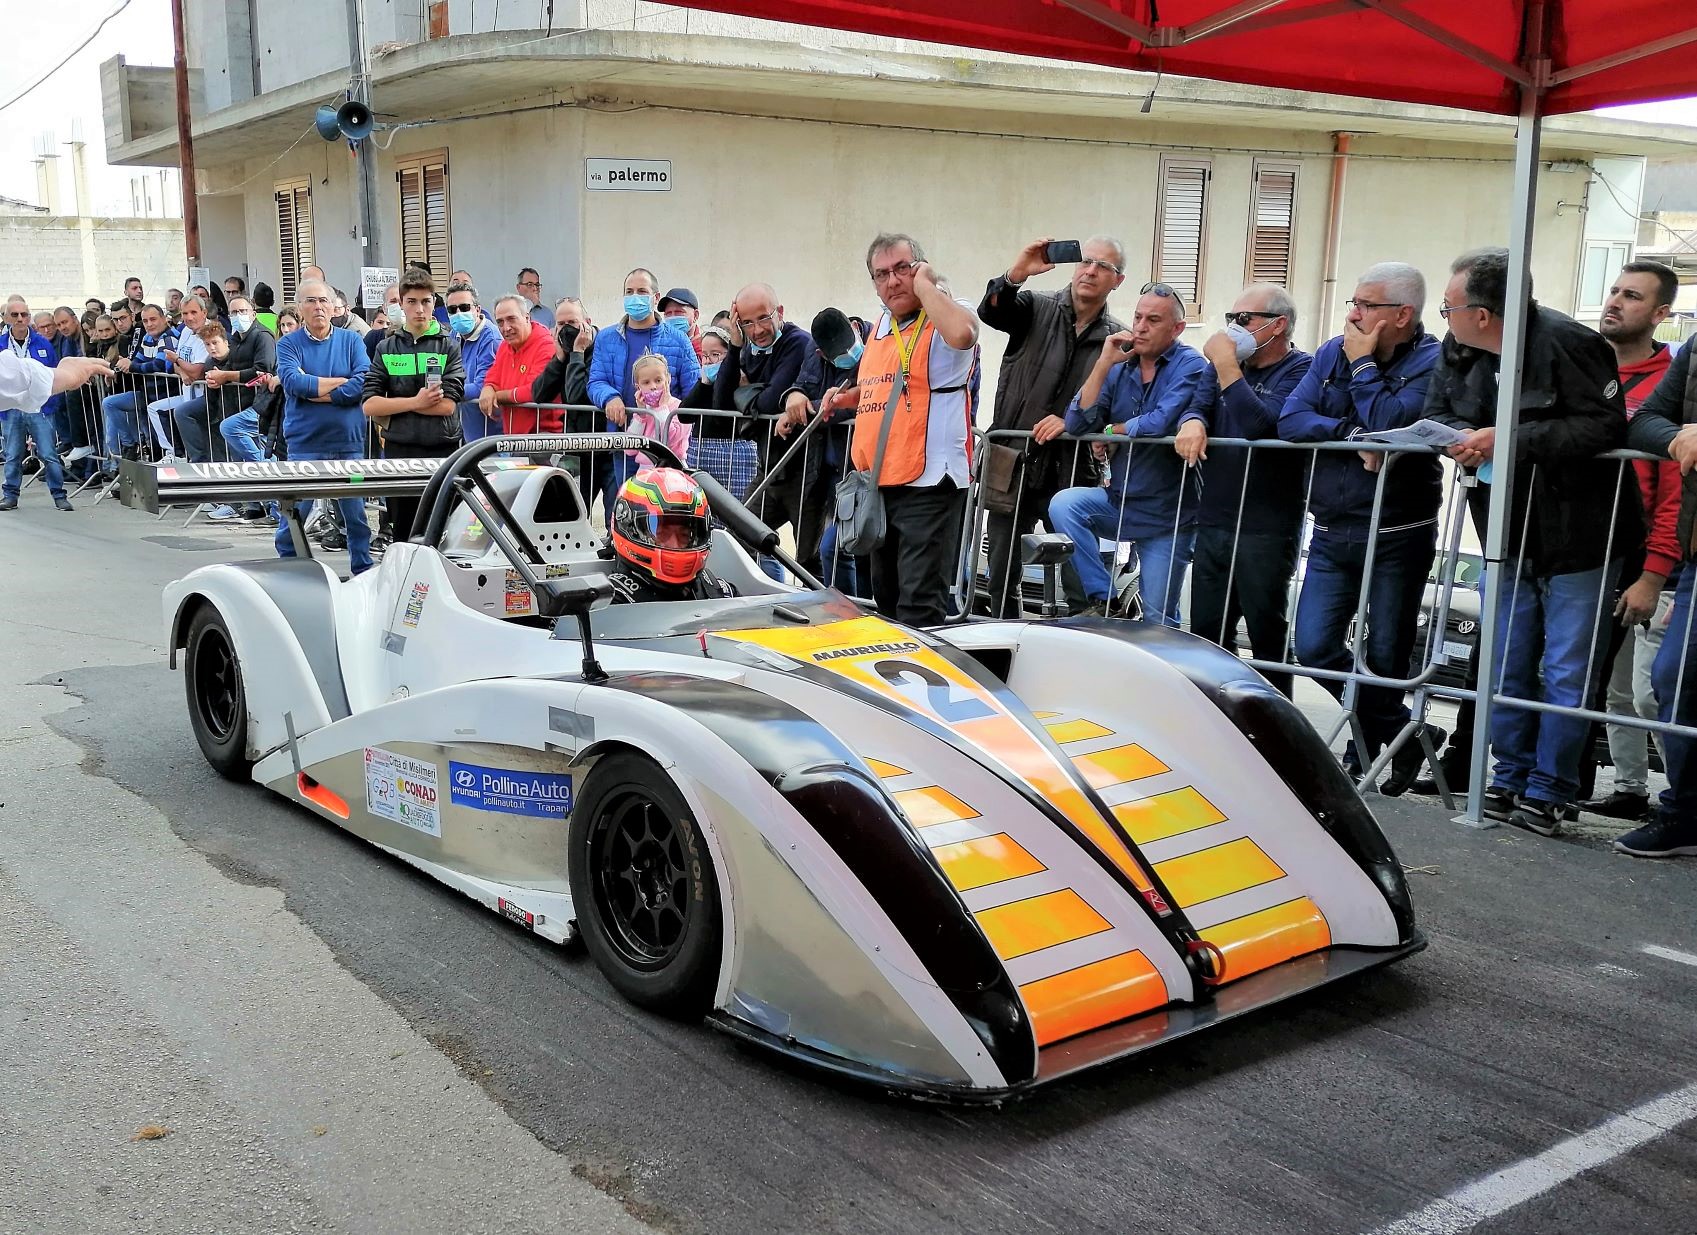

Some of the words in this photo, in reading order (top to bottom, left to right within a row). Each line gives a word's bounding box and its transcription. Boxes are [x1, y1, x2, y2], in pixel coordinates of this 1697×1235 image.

[591, 173, 602, 181] via
[608, 167, 667, 183] palermo
[863, 389, 873, 400] DI
[190, 460, 320, 480] VIRGILIO
[812, 642, 921, 661] MAURIELLO
[873, 660, 1000, 723] 2
[408, 761, 437, 780] Misilmeri
[404, 780, 437, 803] CONAD
[452, 785, 481, 798] HYUNDAI
[483, 797, 526, 809] pollinauto.it
[537, 802, 569, 813] Trapani
[679, 818, 704, 902] AVON
[505, 901, 526, 919] FERODO
